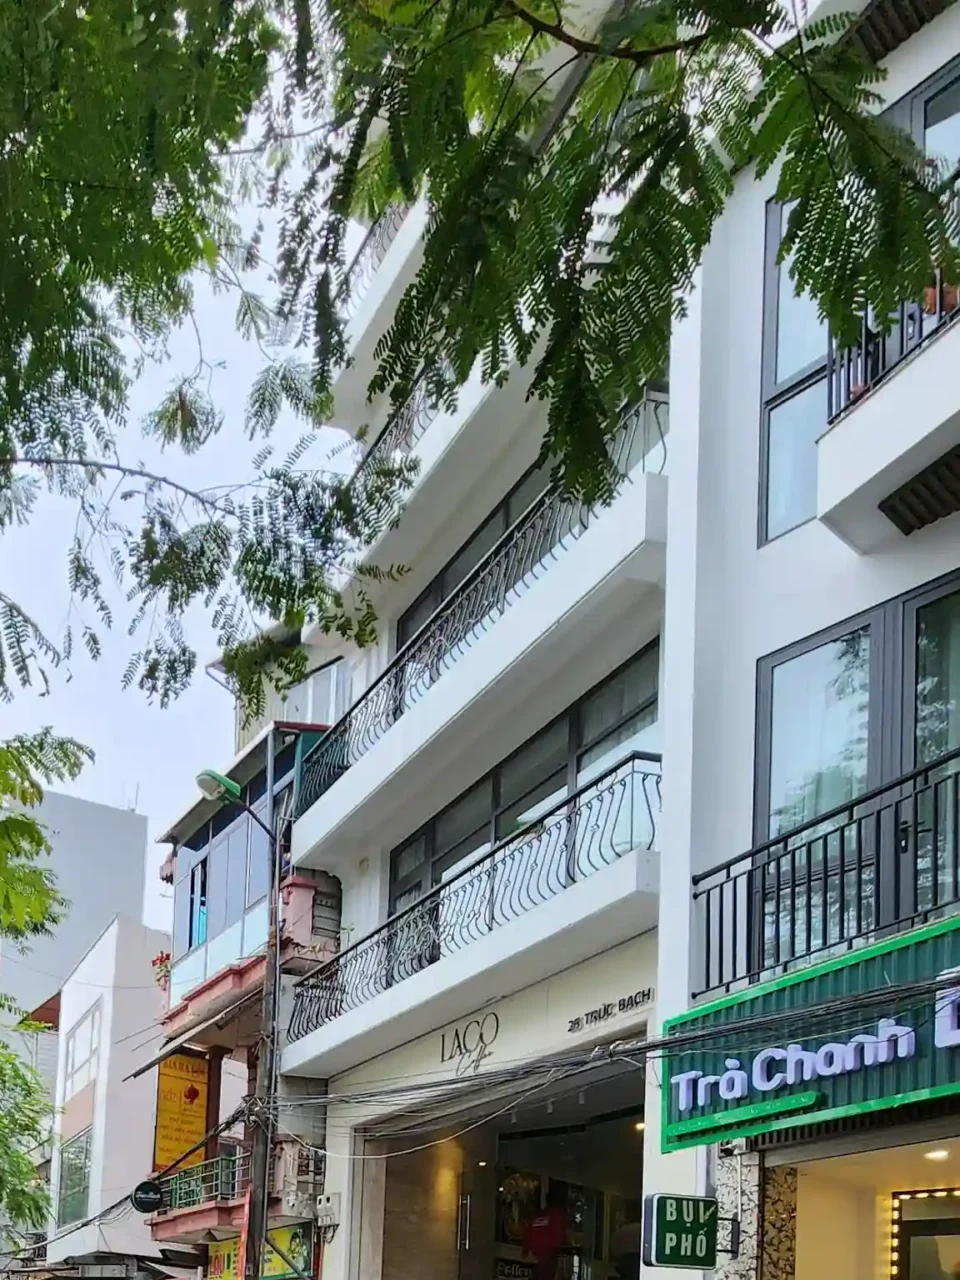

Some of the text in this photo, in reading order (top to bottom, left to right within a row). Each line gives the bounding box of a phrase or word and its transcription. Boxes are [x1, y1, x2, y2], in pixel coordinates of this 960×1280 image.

[440, 1012, 499, 1063] LACO
[670, 1018, 916, 1111] Trà Chanh
[665, 1199, 705, 1227] BỤI
[665, 1227, 707, 1257] PHỐ
